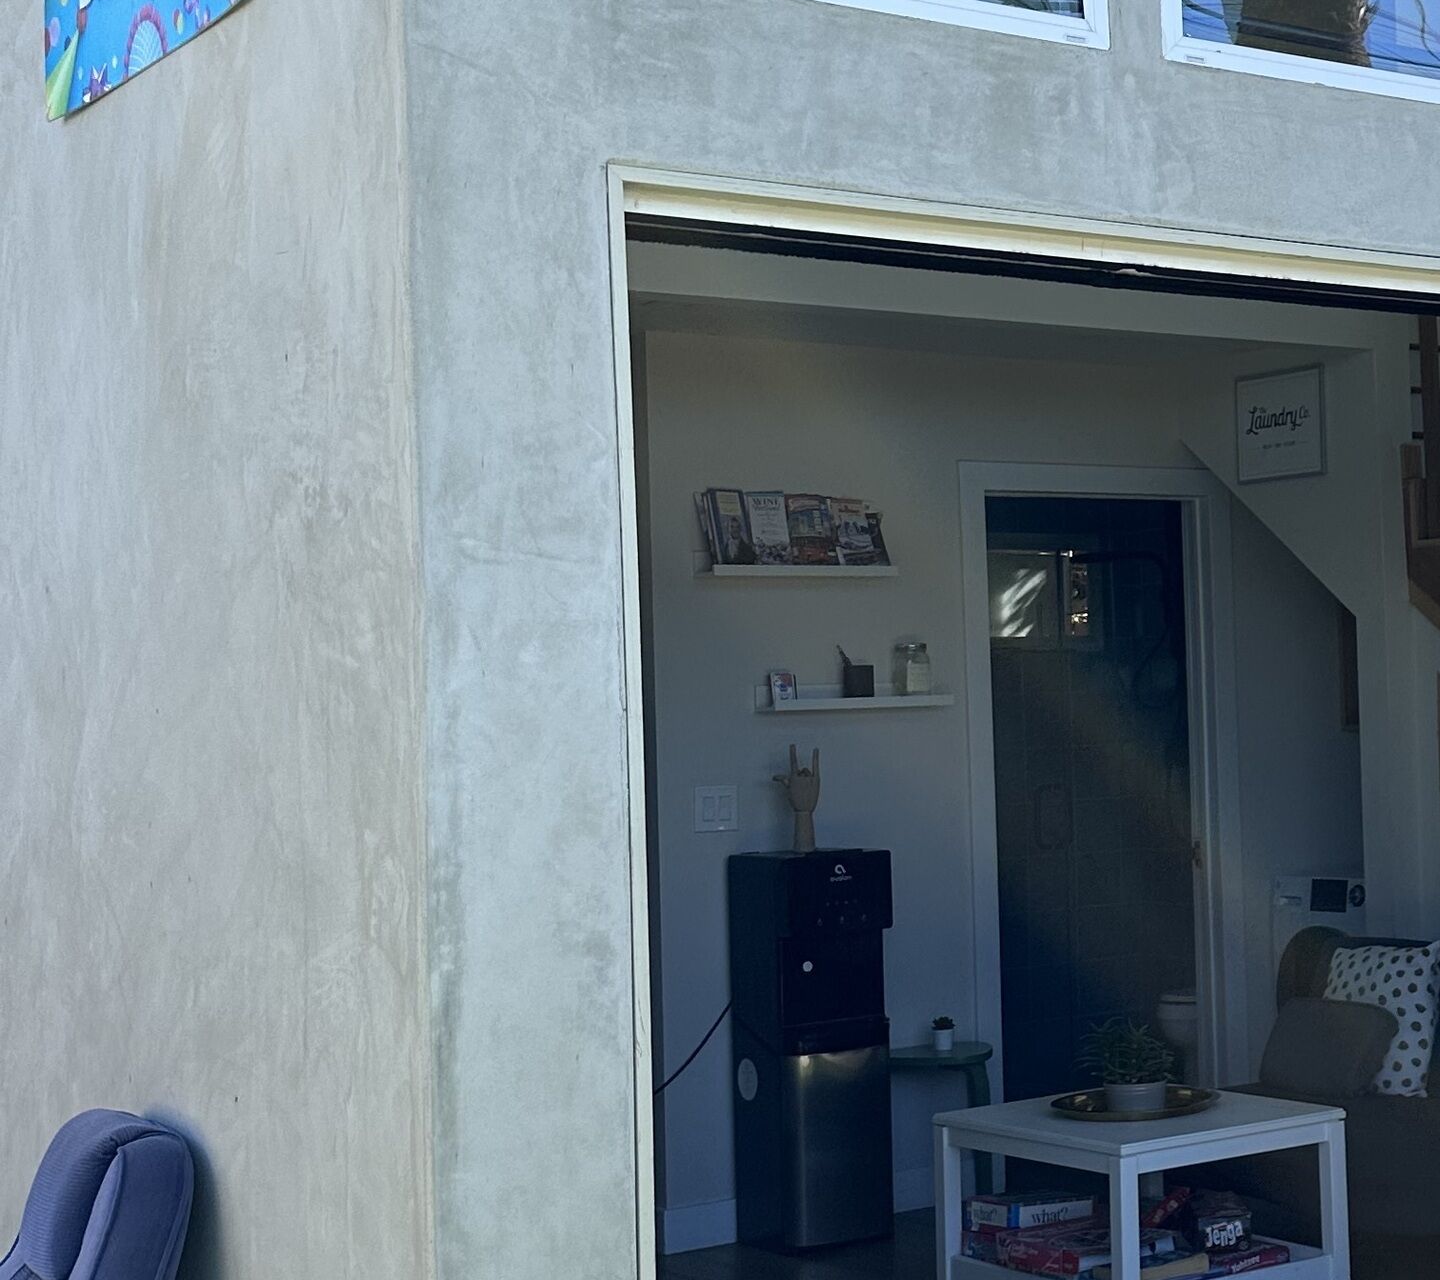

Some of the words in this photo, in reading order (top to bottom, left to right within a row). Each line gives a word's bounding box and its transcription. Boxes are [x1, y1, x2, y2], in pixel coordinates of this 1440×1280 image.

[1245, 406, 1304, 435] Laundry
[1031, 1207, 1069, 1224] what?
[1205, 1221, 1243, 1248] Jenga
